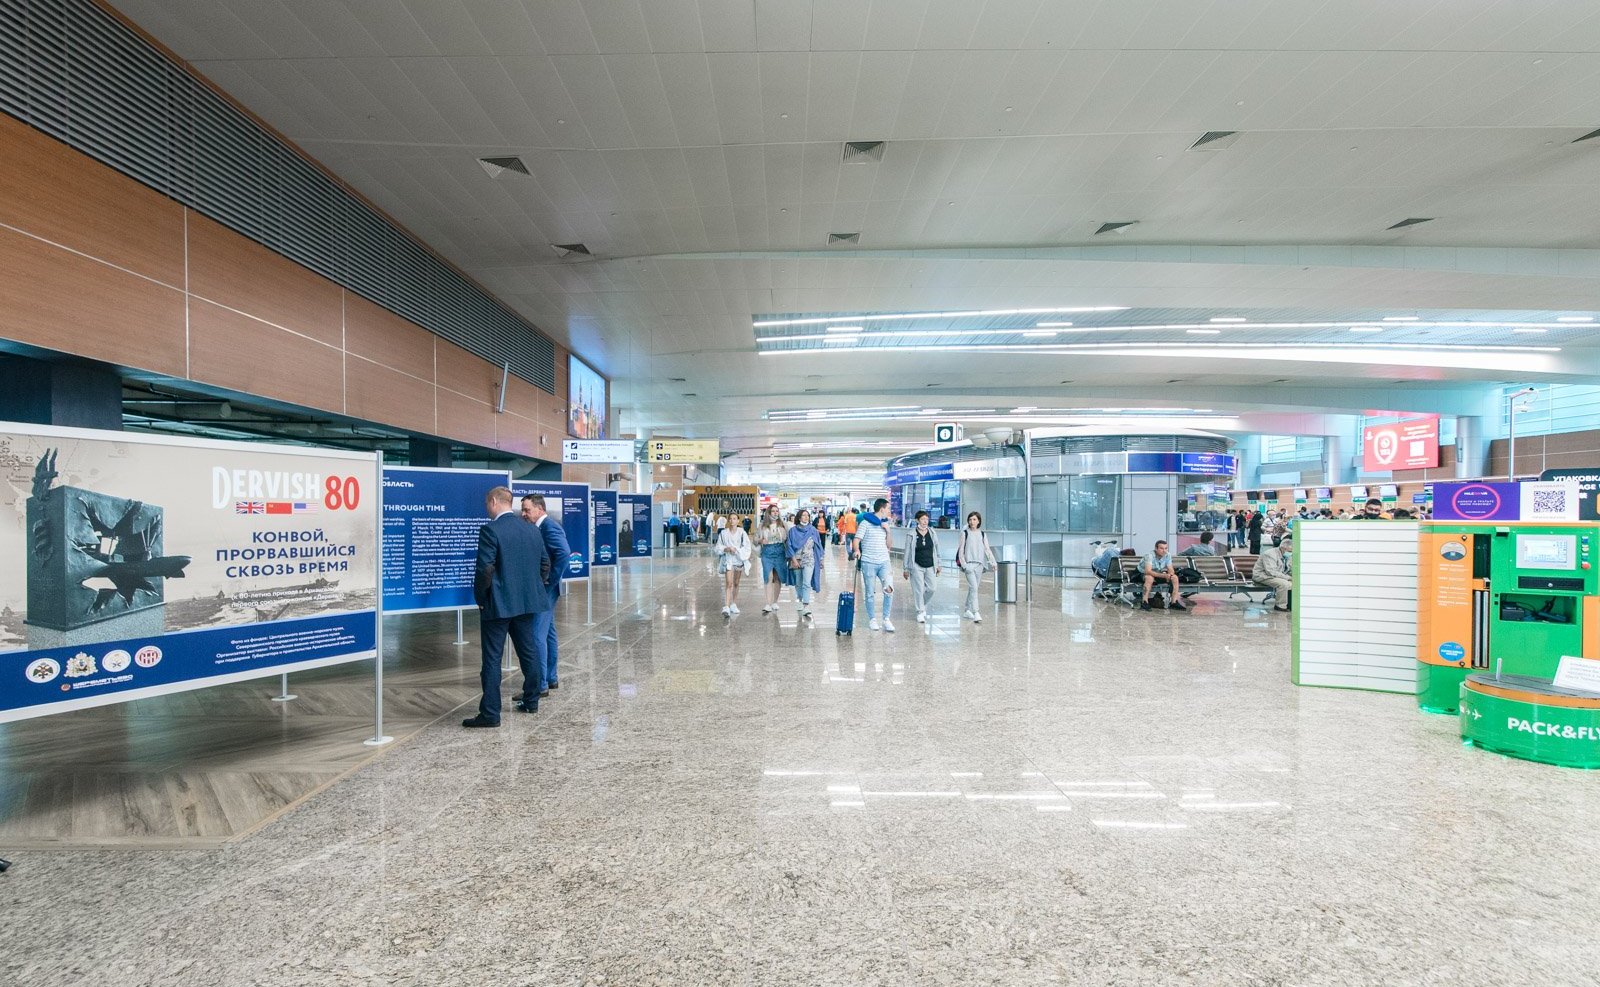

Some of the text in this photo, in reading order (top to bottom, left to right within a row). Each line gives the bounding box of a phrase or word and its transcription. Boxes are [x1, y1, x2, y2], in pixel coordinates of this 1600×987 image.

[212, 466, 360, 511] DERVISH 80
[252, 528, 329, 543] КОНВОЙ,
[216, 543, 356, 562] ПРОРВАВШИЙСЯ
[225, 560, 348, 578] СКВОЗЬ ВРЕМЯ
